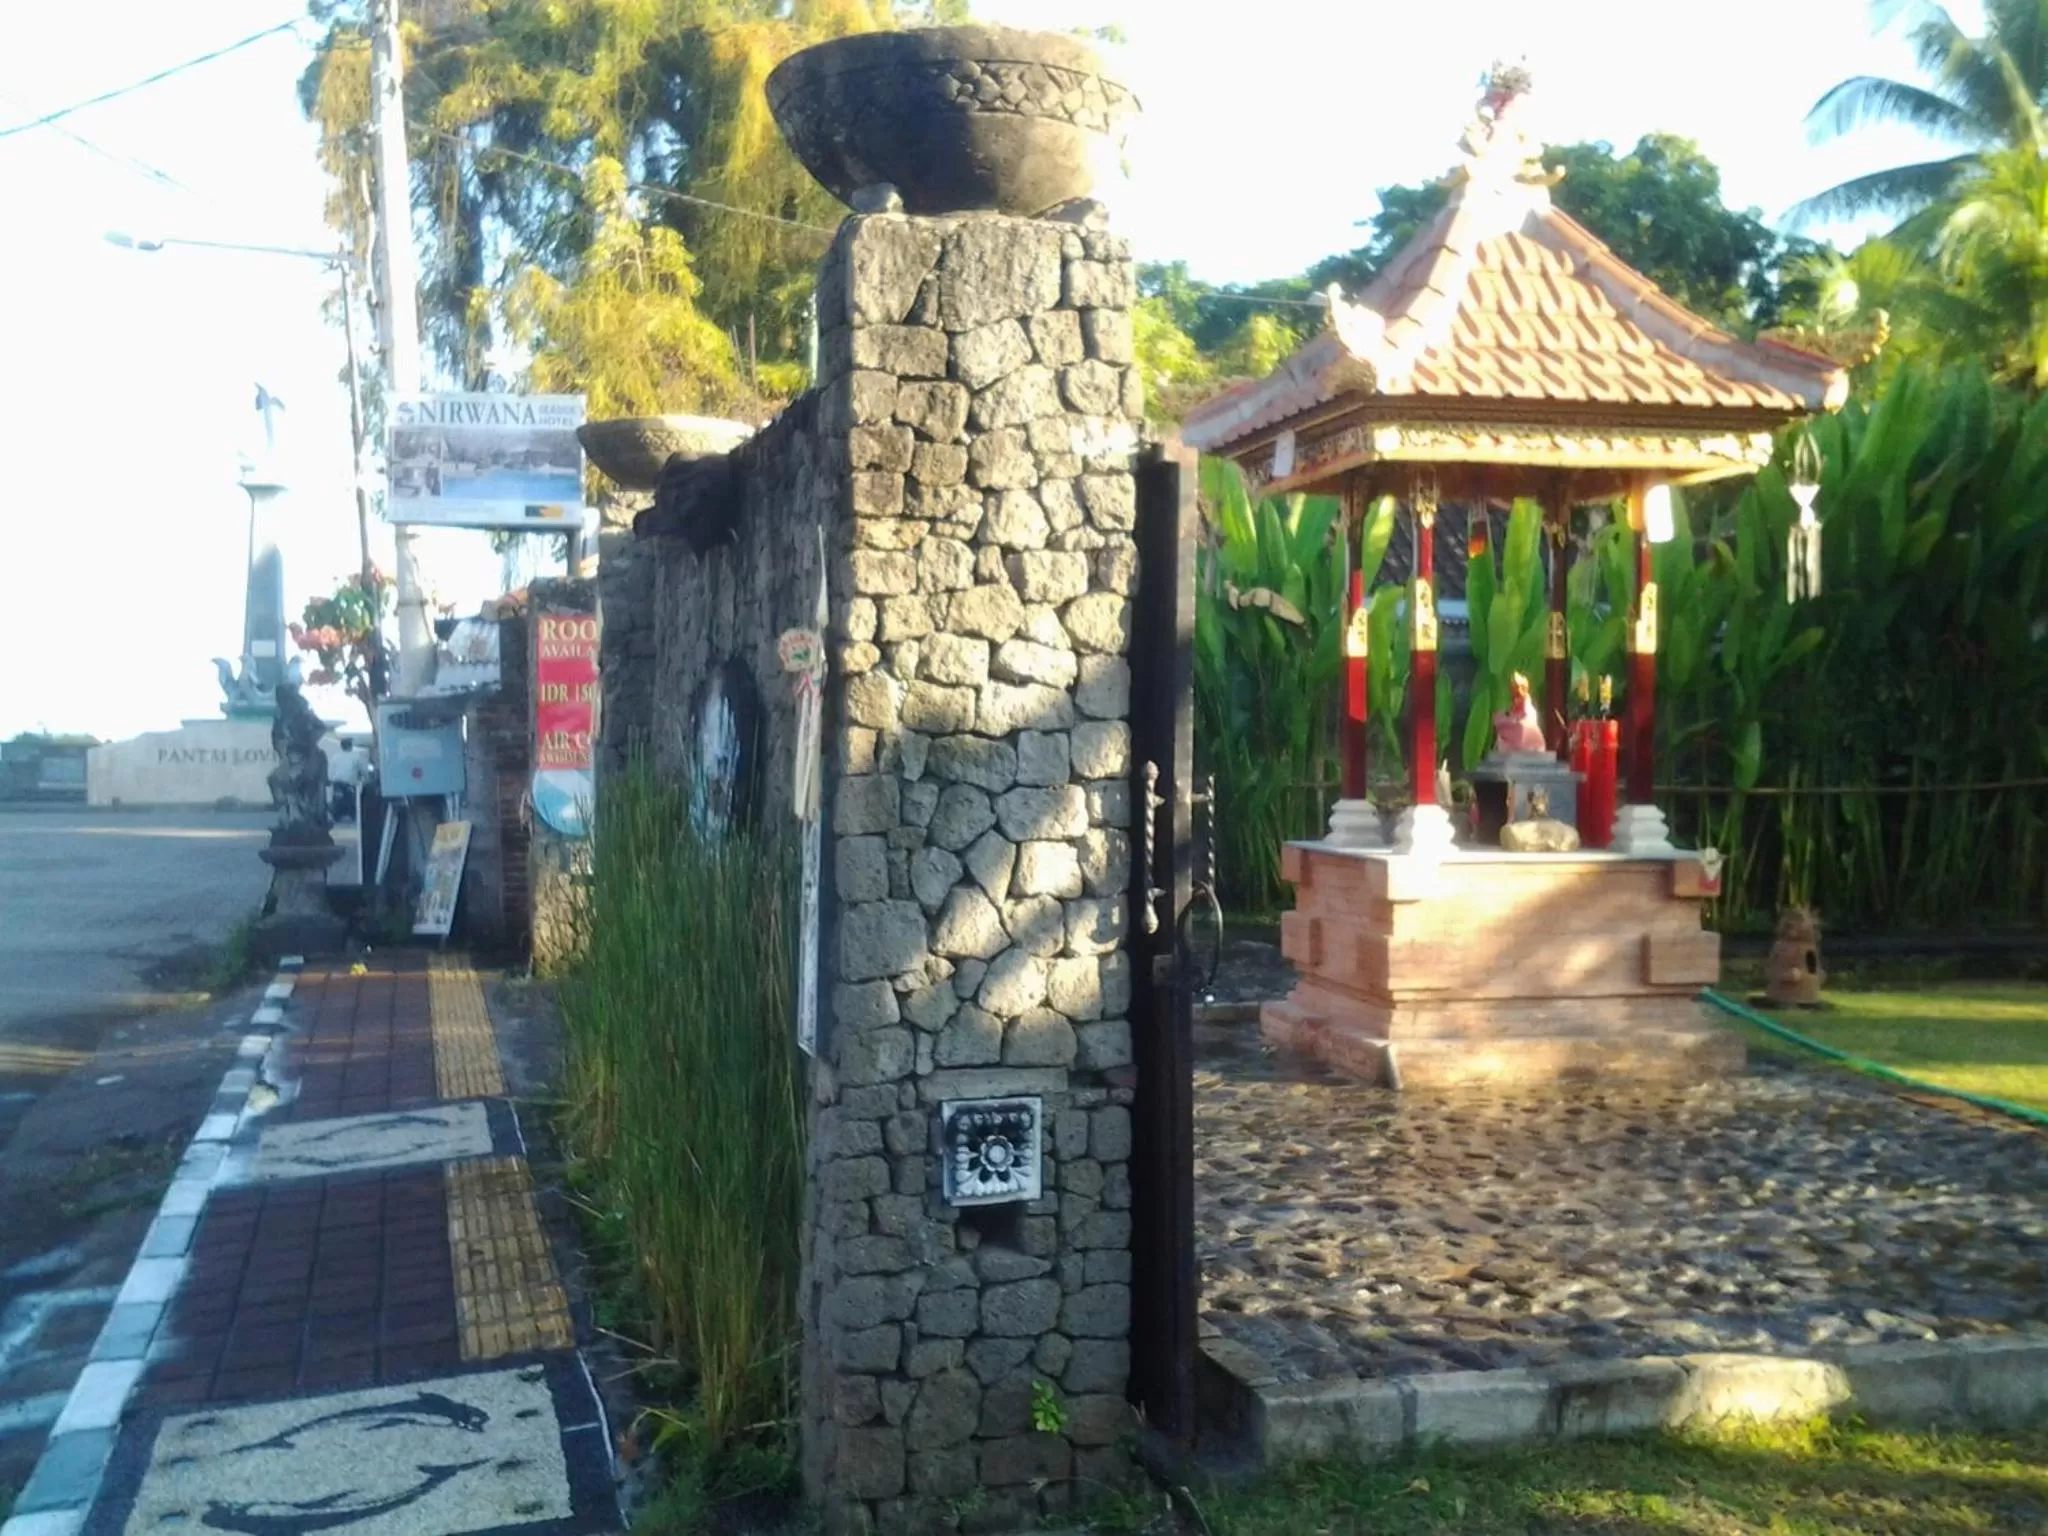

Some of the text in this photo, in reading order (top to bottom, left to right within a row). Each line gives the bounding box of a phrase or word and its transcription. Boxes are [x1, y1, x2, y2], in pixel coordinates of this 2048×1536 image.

[419, 400, 536, 425] NIRWANA
[541, 683, 568, 702] IDR
[542, 731, 569, 750] AIR
[158, 747, 227, 765] PANTAI
